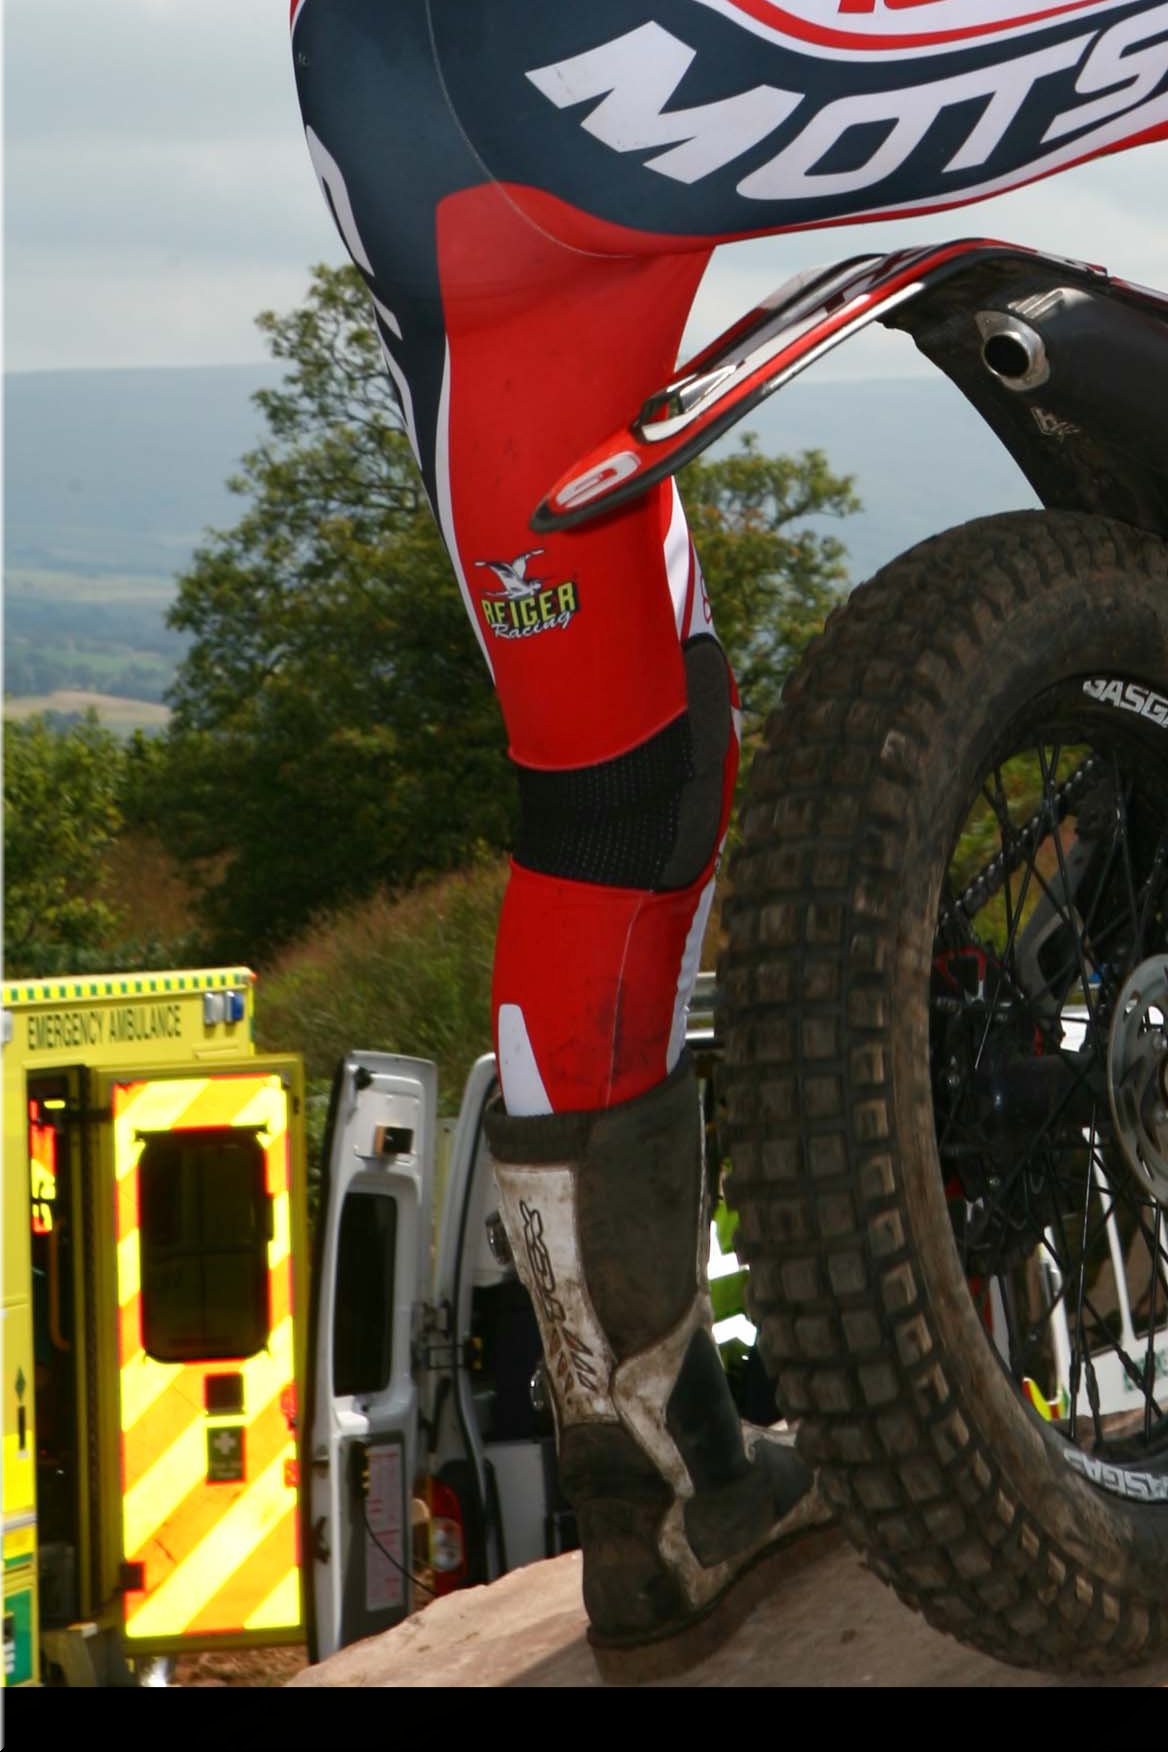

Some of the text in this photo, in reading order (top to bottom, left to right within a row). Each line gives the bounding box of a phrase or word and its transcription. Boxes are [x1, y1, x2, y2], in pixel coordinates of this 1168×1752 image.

[481, 581, 577, 629] REIGER
[491, 610, 572, 639] Racing
[28, 1004, 181, 1050] EMERGENCY AMBULANCE
